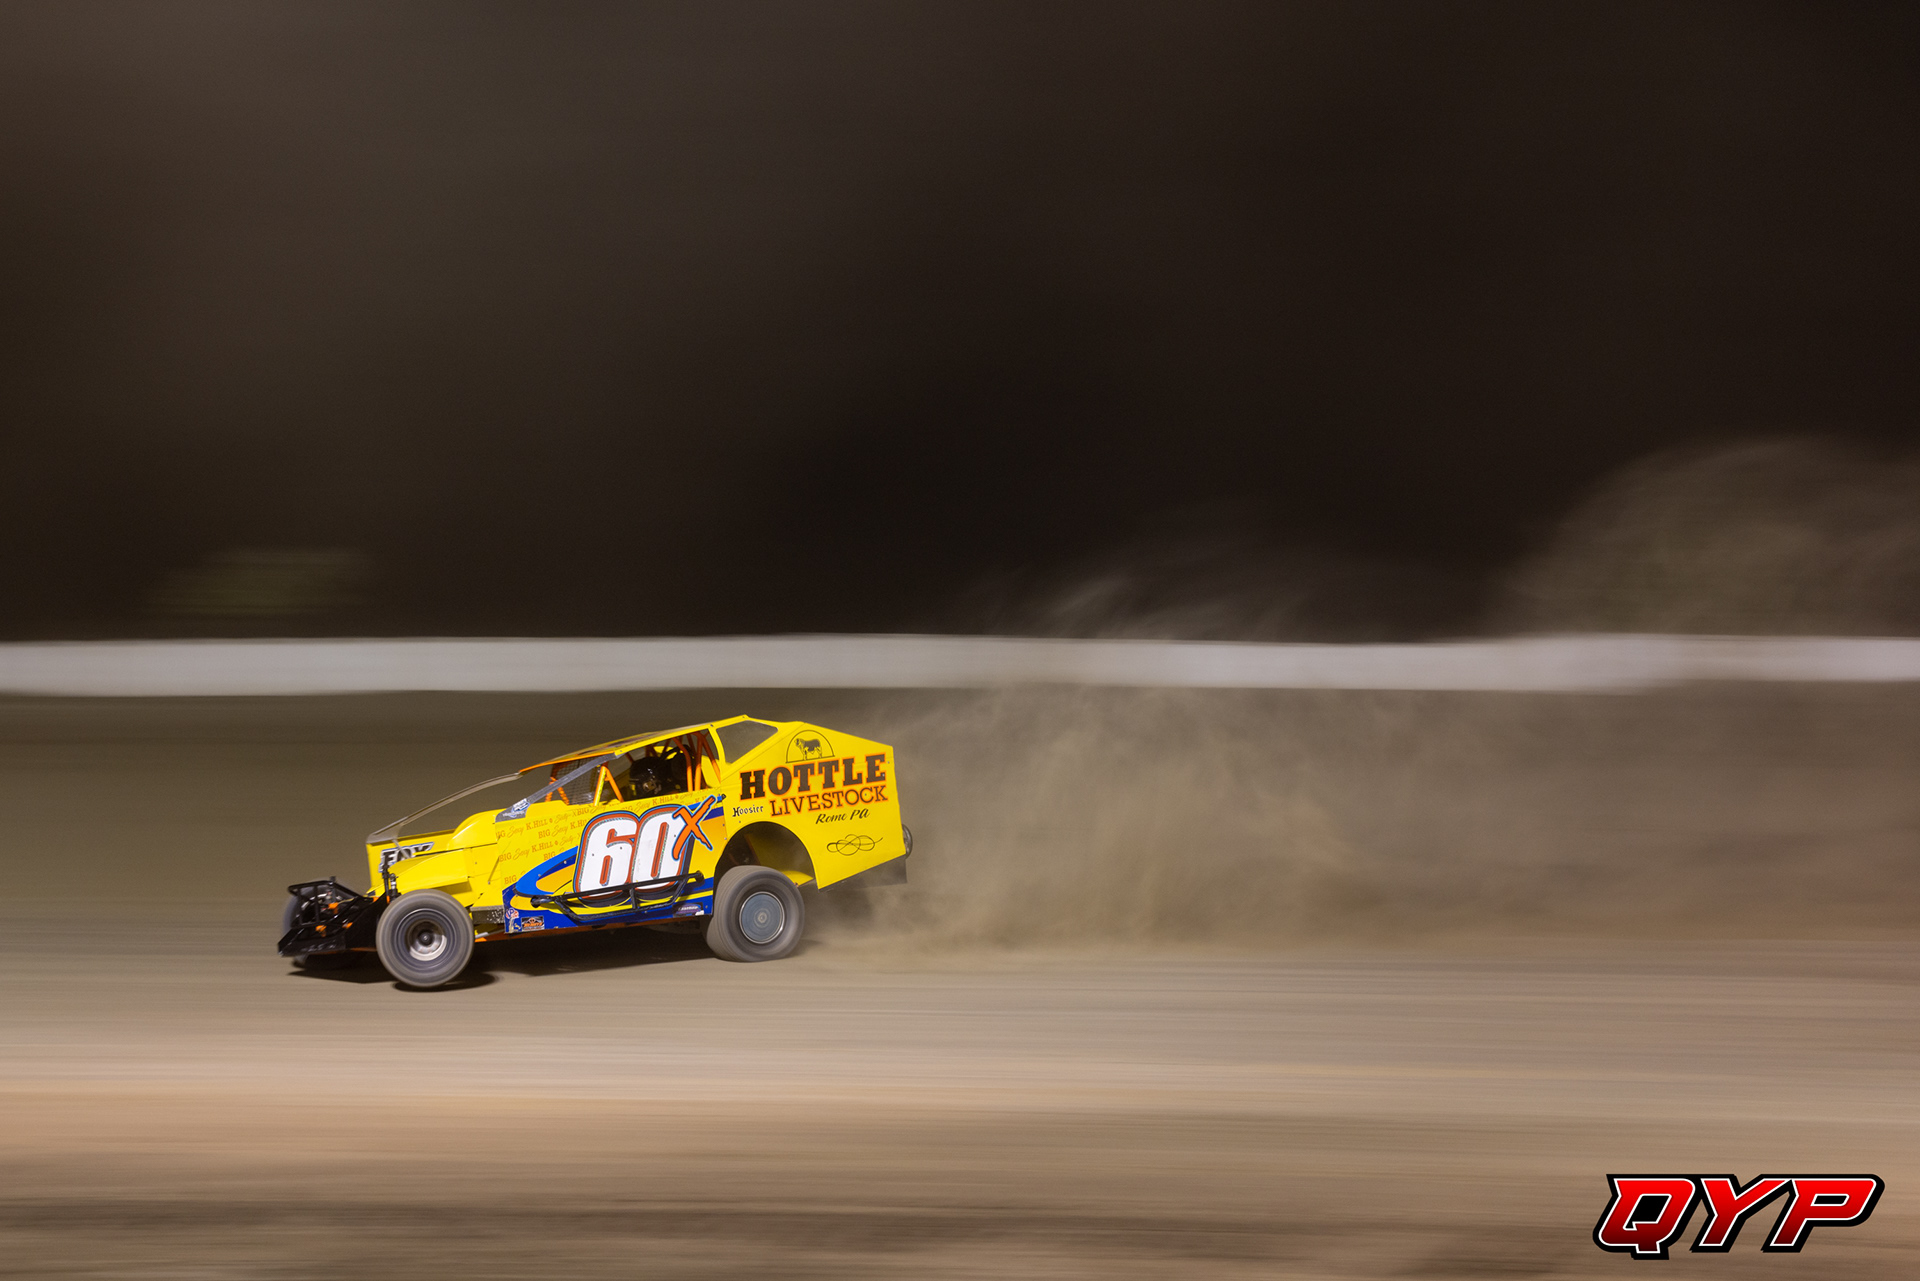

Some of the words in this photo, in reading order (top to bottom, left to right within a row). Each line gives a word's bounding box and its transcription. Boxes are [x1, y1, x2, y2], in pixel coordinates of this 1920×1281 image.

[740, 752, 886, 800] HOTTLE
[769, 784, 888, 817] LIVESTOCK
[732, 804, 764, 817] Hoosier
[815, 813, 847, 824] Rome
[538, 829, 550, 839] BIG
[500, 852, 511, 862] BIG
[544, 851, 555, 861] BIG
[504, 875, 517, 885] BIG
